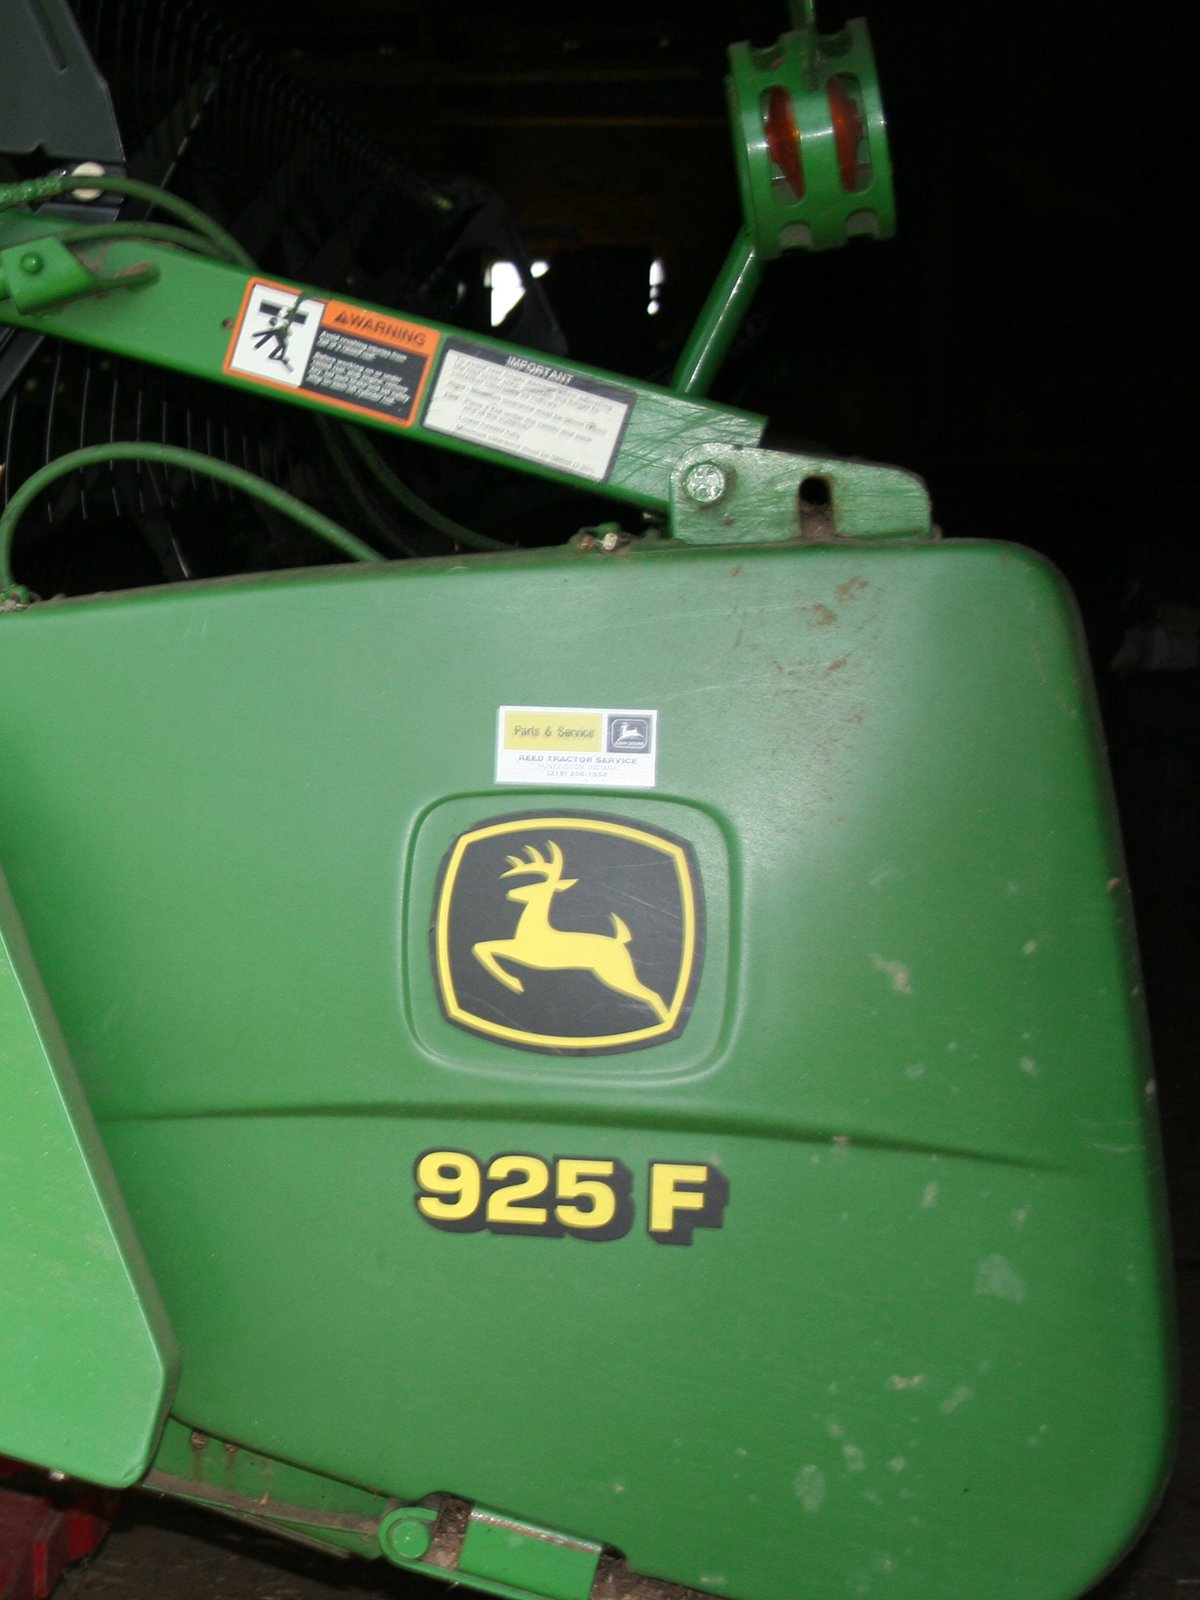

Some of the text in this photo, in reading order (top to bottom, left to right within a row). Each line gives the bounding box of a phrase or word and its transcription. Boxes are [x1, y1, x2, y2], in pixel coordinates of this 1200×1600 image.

[349, 312, 426, 346] WARNING
[506, 356, 573, 384] IMPORTANT
[514, 725, 595, 738] Parts & Service
[519, 754, 639, 764] REED TRACTOR SERVICE
[415, 1149, 717, 1238] 925 F
